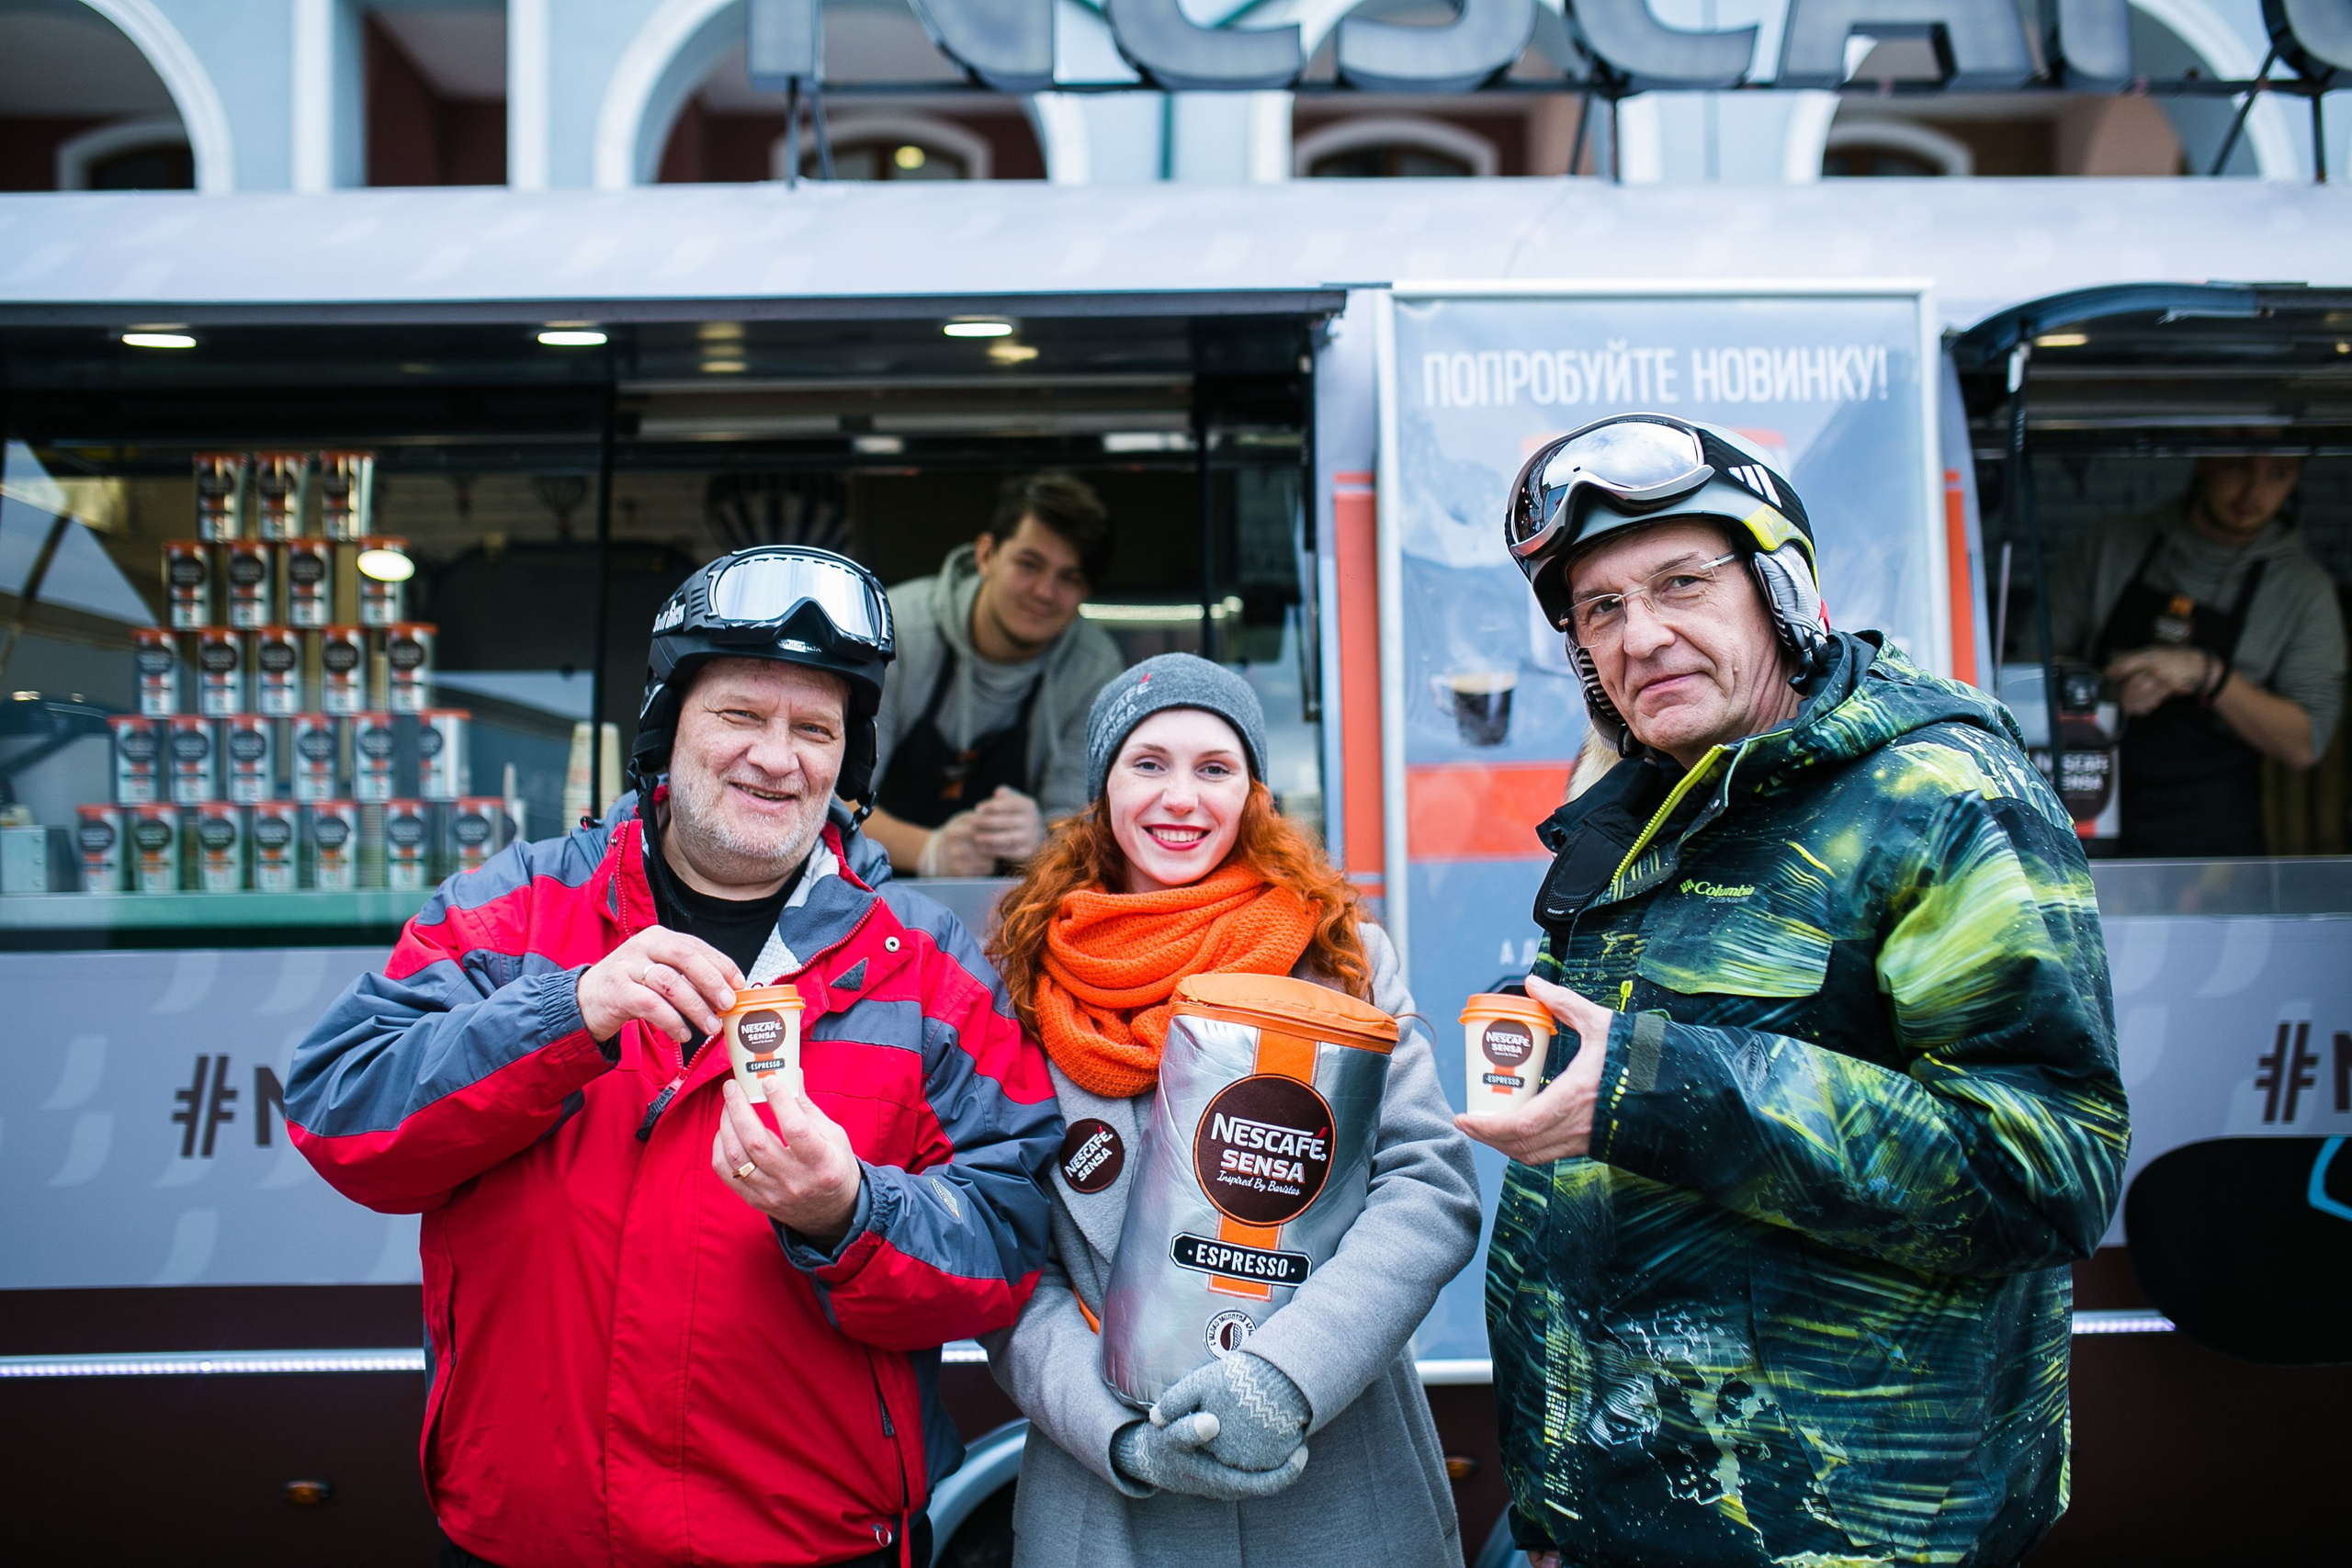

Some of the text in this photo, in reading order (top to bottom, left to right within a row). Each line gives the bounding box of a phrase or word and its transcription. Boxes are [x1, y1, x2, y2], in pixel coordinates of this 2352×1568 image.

[1422, 339, 1889, 408] ПОПРОБУЙТЕ НОВИНКУ!
[748, 1031, 776, 1041] SENSA
[1491, 1043, 1522, 1055] SENSA
[751, 1060, 780, 1070] ESPRESSO
[1078, 1147, 1113, 1181] SENSA
[1220, 1148, 1305, 1184] SENSA
[1216, 1169, 1301, 1196] Inspired By Baristas
[1195, 1243, 1287, 1278] ESPRESSO
